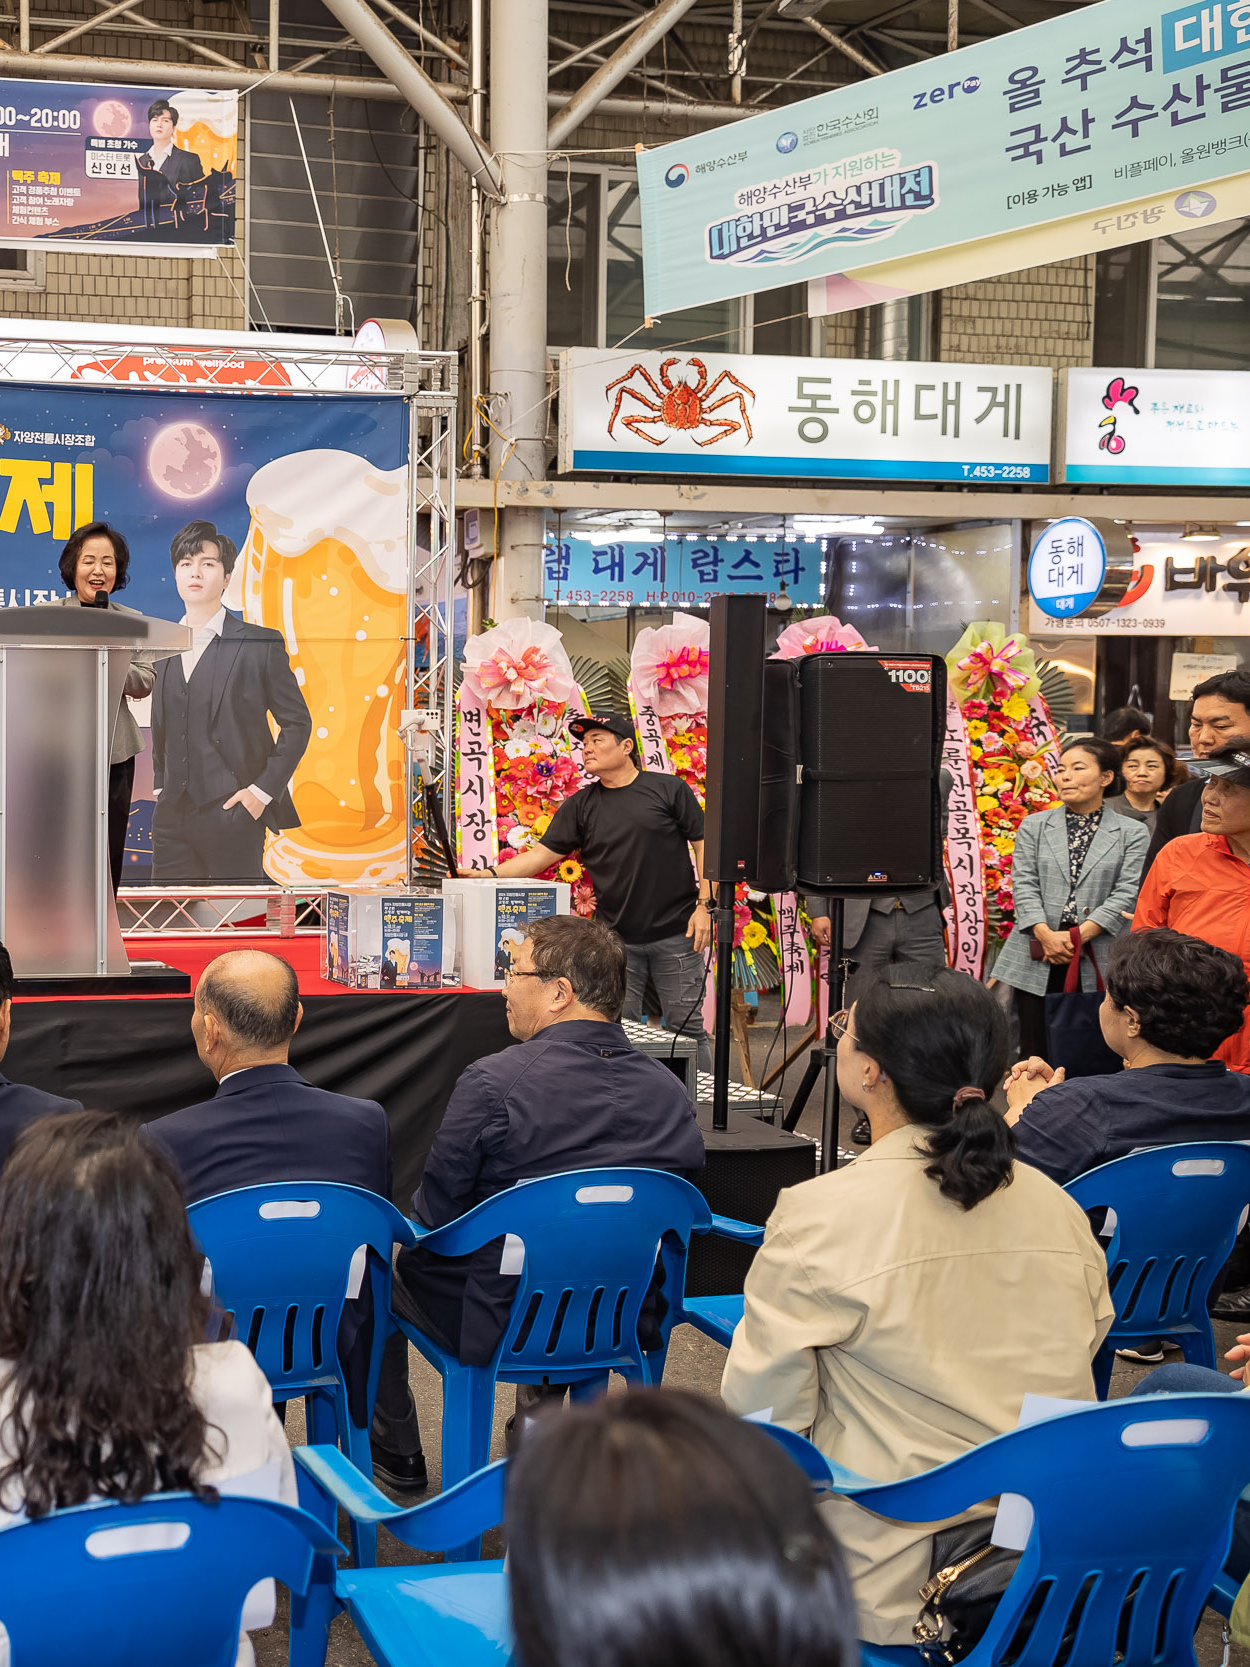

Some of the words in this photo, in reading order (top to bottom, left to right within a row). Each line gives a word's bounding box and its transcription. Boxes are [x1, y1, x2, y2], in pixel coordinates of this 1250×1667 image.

[1003, 66, 1045, 114] 올
[1062, 27, 1153, 92] 추석
[816, 107, 878, 137] 한국수산회
[123, 140, 138, 149] 가수
[1005, 108, 1095, 165] 국산
[91, 152, 113, 161] 미스터
[695, 151, 748, 174] 해양수산부
[12, 170, 35, 184] 맥주
[38, 171, 60, 185] 축제
[738, 170, 829, 206] 해양수산부가
[832, 151, 896, 180] 지원하는
[12, 185, 26, 194] 고객
[59, 187, 81, 197] 이벤트
[12, 196, 26, 204] 고객
[1007, 188, 1039, 210] [이용
[1042, 182, 1070, 199] 가능
[1072, 174, 1093, 195] 앱]
[12, 216, 27, 225] 간식
[45, 217, 60, 226] 부스
[710, 166, 934, 258] 대한민국수산대전
[788, 376, 1023, 444] 동해대게
[13, 429, 96, 447] 자양전통시장조합
[962, 464, 1031, 480] T.453-2258
[1048, 535, 1084, 565] 동해
[592, 543, 666, 583] 대게
[691, 546, 805, 585] 랍스타
[1048, 563, 1083, 588] 대게
[554, 590, 634, 602] T.453-2258
[1088, 618, 1165, 630] 0507-1323-0939
